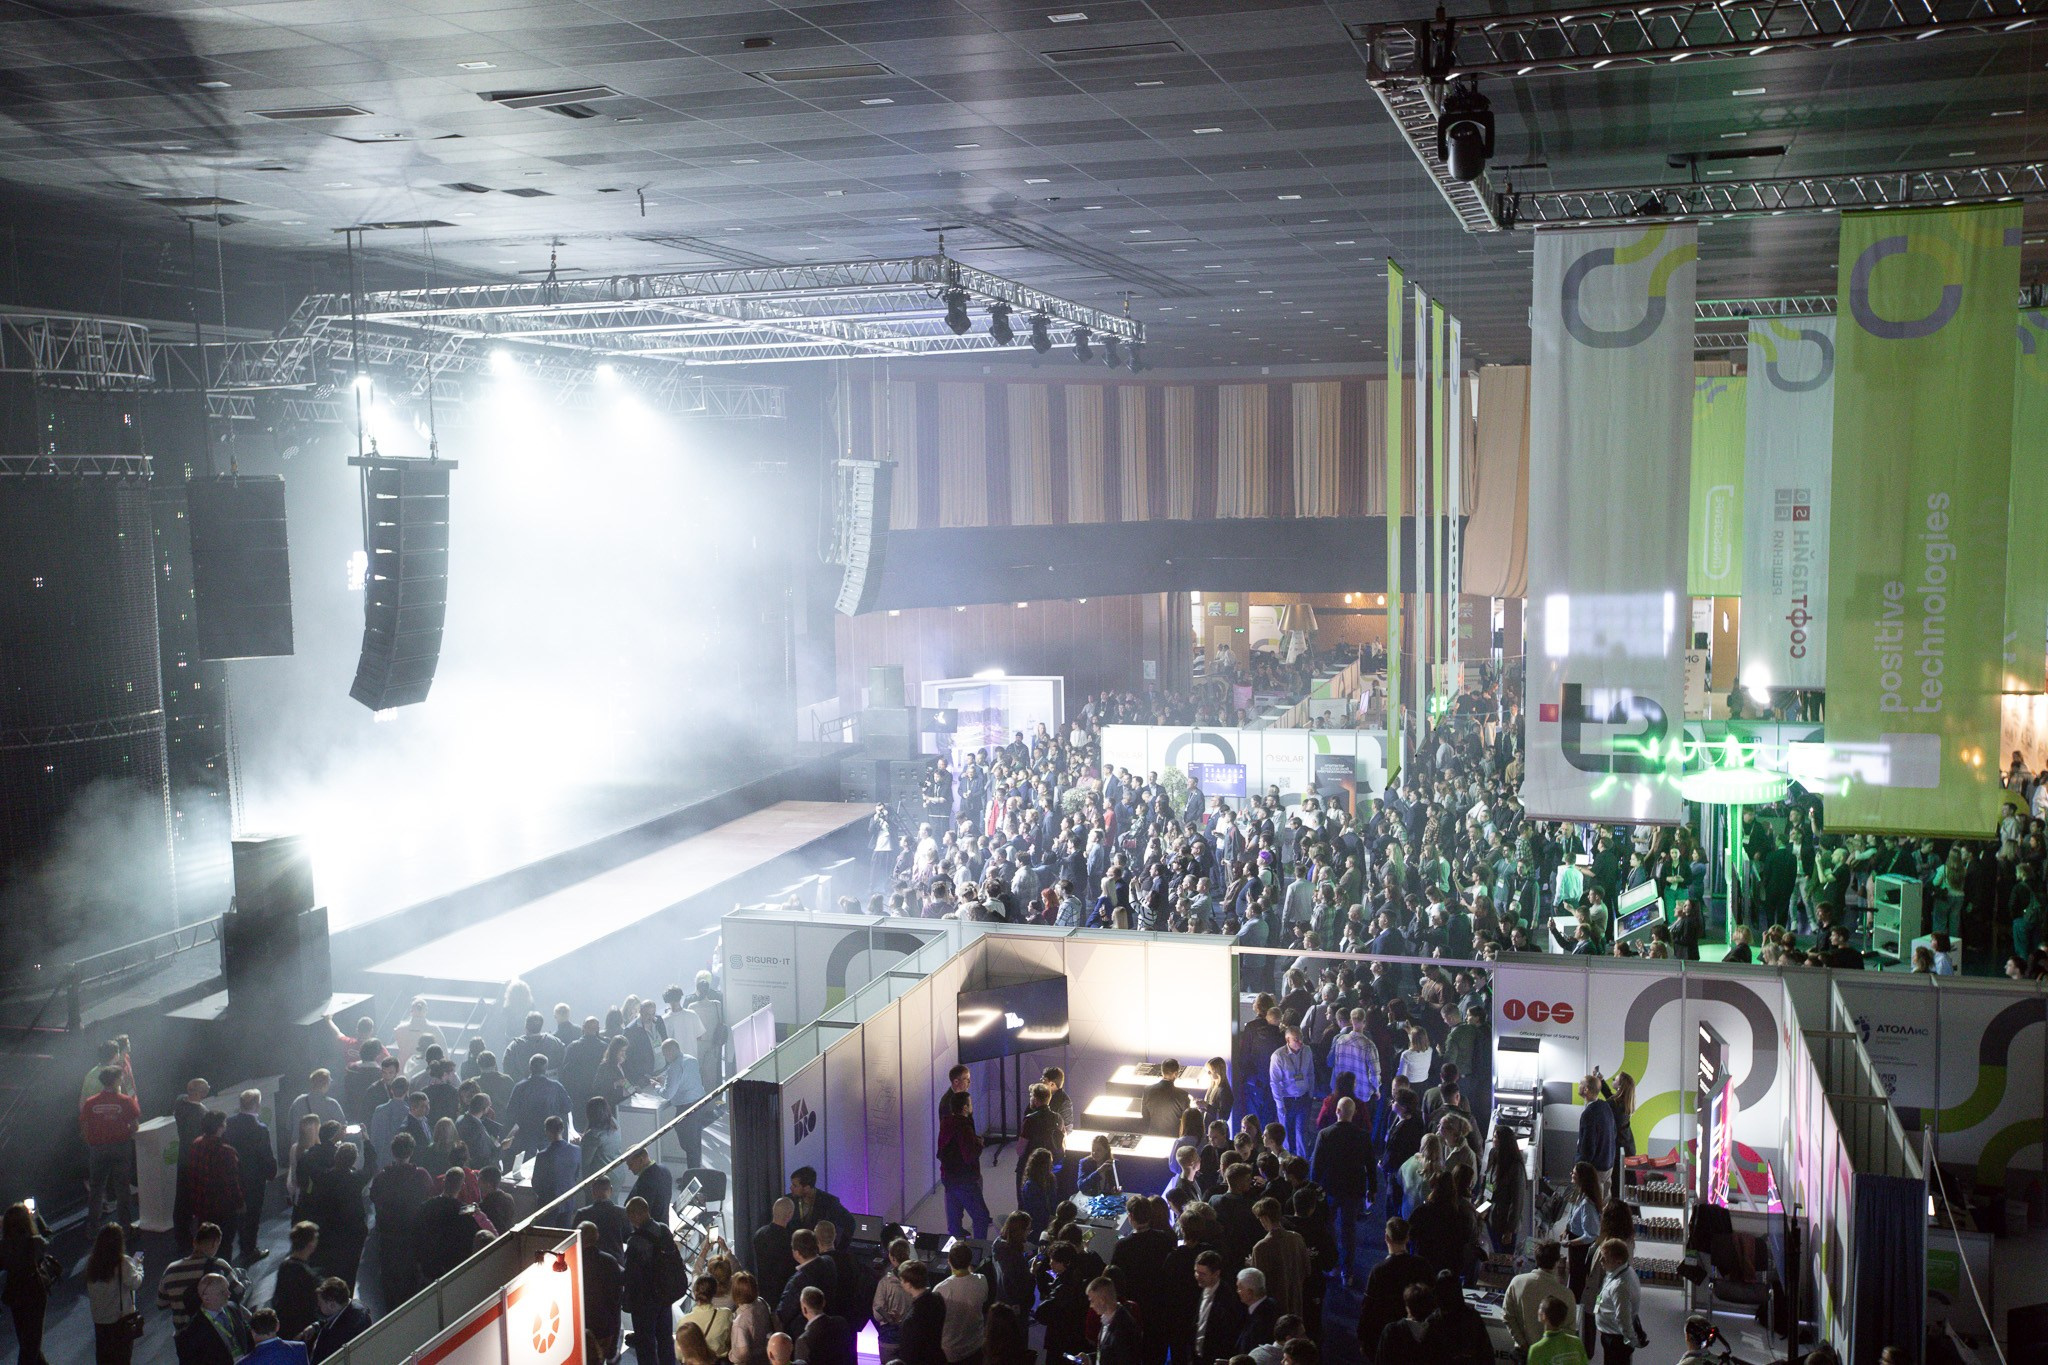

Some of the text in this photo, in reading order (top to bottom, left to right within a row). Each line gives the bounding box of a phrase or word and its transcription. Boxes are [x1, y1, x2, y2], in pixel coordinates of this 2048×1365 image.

[1873, 580, 1909, 713] positive
[1912, 491, 1957, 713] technologies
[1275, 755, 1304, 763] SOLAR
